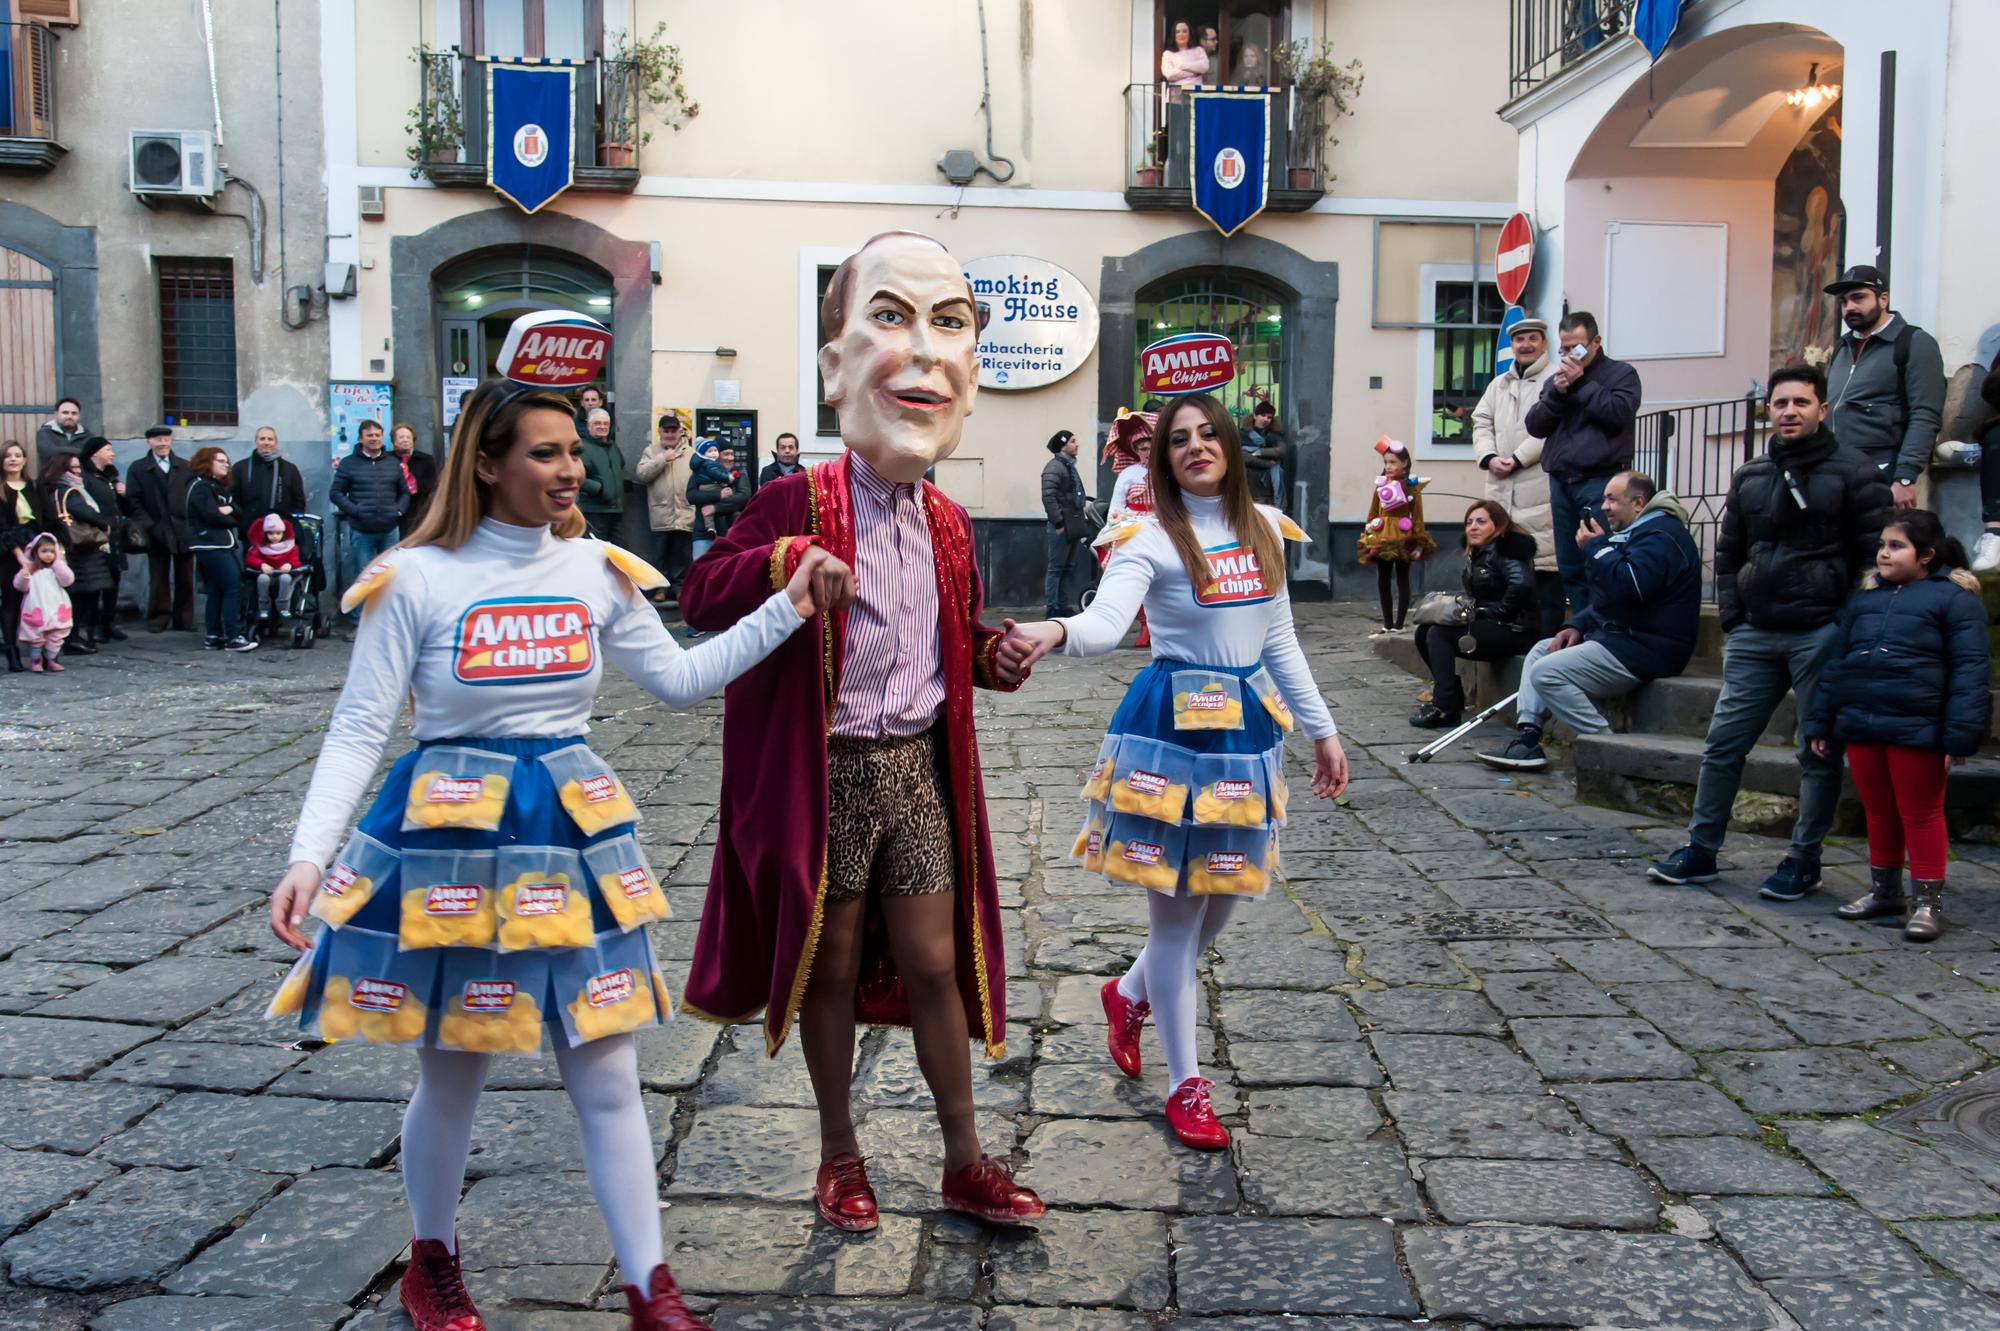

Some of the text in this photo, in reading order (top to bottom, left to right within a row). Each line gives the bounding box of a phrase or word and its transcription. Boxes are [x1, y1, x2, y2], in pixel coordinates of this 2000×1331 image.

[963, 272, 1059, 300] moking
[1004, 297, 1078, 322] House
[517, 332, 605, 360] AMICA
[535, 359, 575, 381] Chips
[982, 358, 1062, 371] Ricevitoria
[1147, 346, 1230, 376] AMICA
[1171, 368, 1209, 386] Chips
[1219, 575, 1263, 596] chips
[468, 612, 584, 647] AMICA
[493, 641, 567, 670] chips
[1191, 694, 1224, 703] AMICA
[1132, 771, 1166, 787] AMICA
[1217, 781, 1250, 792] AMICA
[1210, 853, 1243, 863] AMICA
